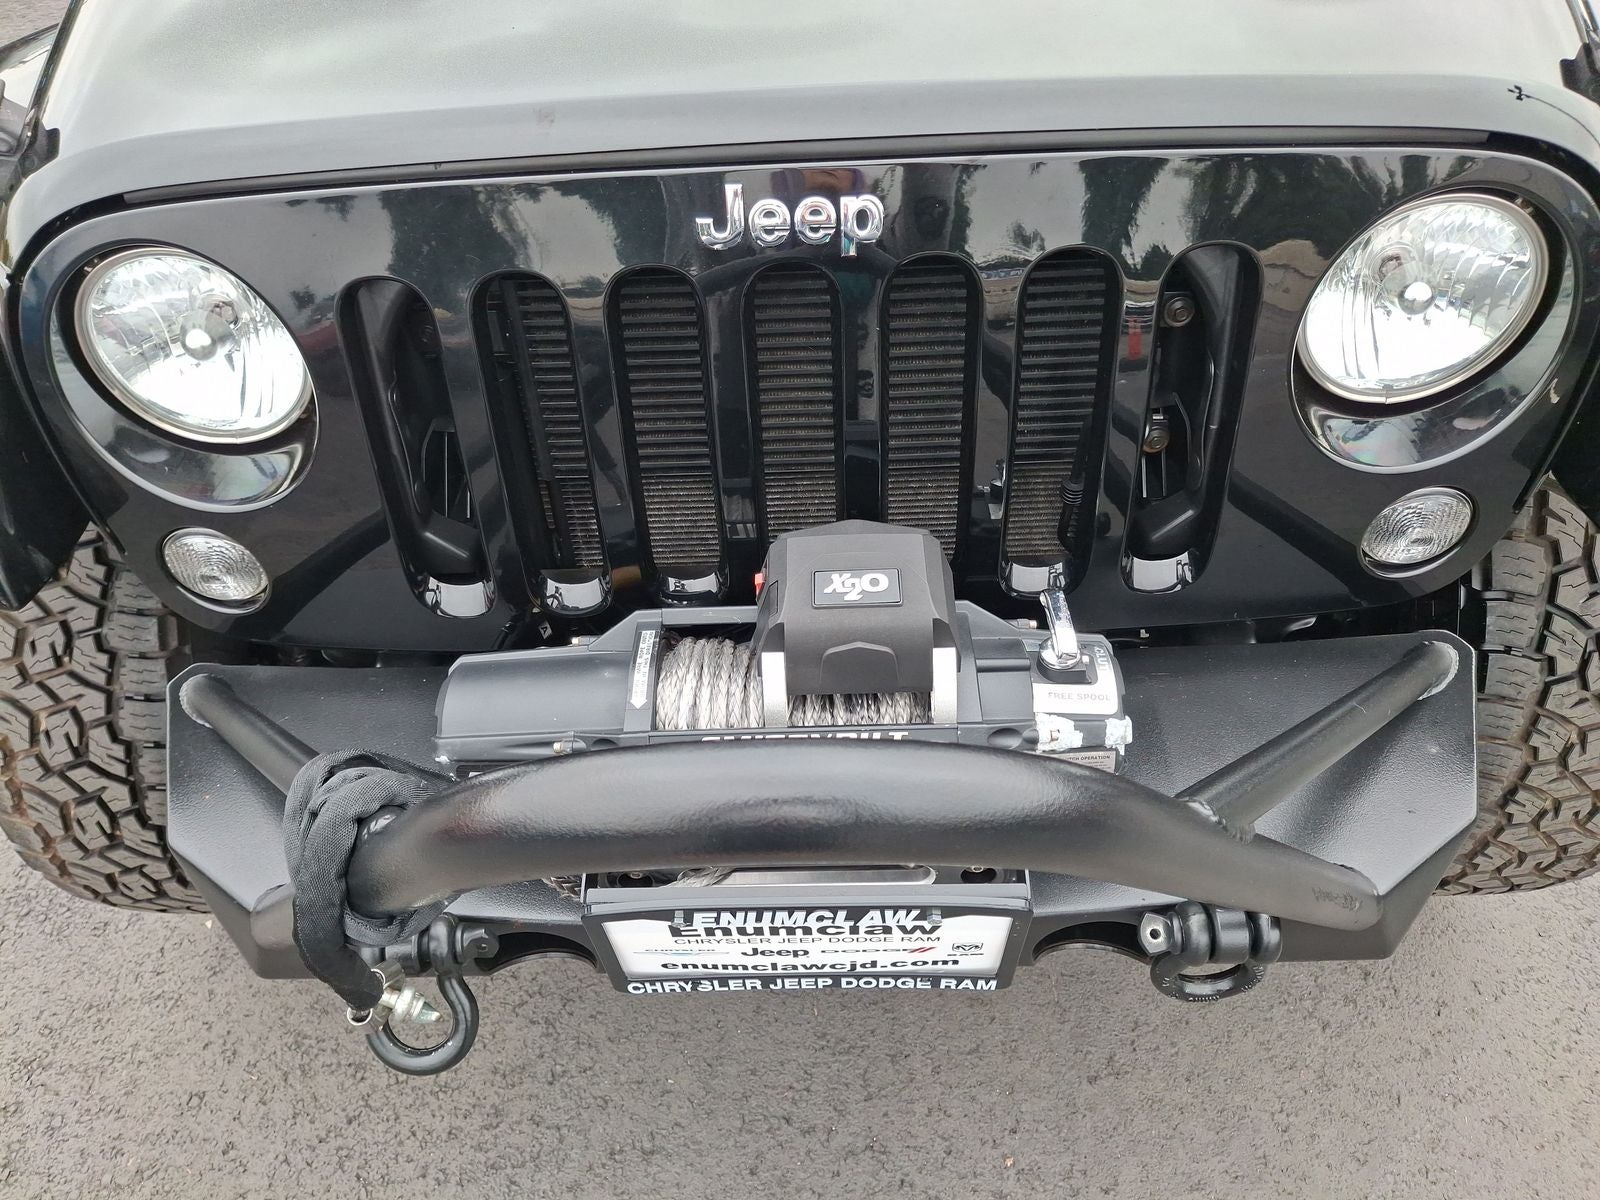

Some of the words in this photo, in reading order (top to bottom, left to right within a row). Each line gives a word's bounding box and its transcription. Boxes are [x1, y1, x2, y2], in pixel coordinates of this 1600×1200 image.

[696, 183, 885, 257] Jeep
[823, 572, 889, 601] X2O
[1047, 691, 1073, 700] FREE
[1076, 692, 1111, 701] SPOOL
[692, 909, 921, 927] ENUMCLAW
[668, 924, 942, 938] Enumclaw
[740, 947, 810, 958] Jeep
[660, 959, 960, 972] enumclawcjd.com
[627, 979, 762, 994] CHRYSLER
[769, 977, 833, 990] JEEP
[840, 977, 932, 989] DODGE
[939, 977, 998, 991] RAM
